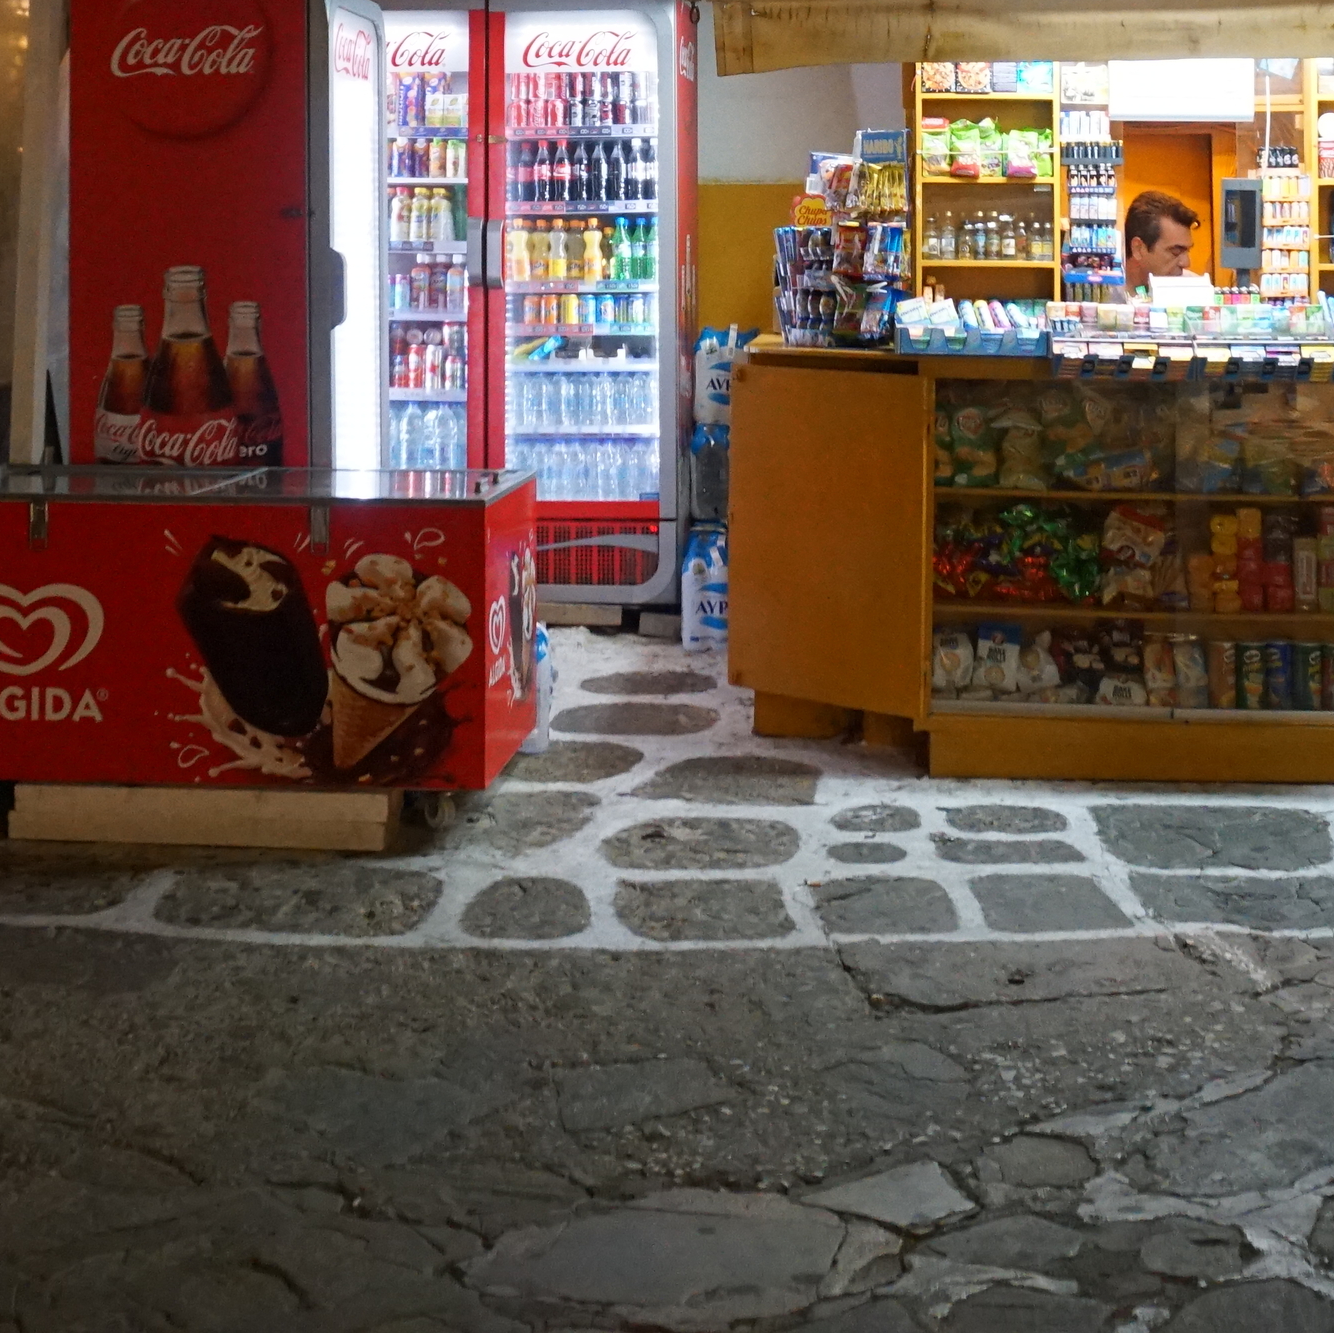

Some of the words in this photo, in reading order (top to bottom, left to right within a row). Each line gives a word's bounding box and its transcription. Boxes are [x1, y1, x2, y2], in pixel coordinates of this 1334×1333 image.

[110, 24, 264, 78] Coca-Cola
[523, 30, 640, 68] Coca-Cola
[797, 215, 828, 226] Chups
[798, 205, 828, 217] Chupa
[139, 417, 239, 467] Coca-Cola
[239, 444, 268, 458] ero
